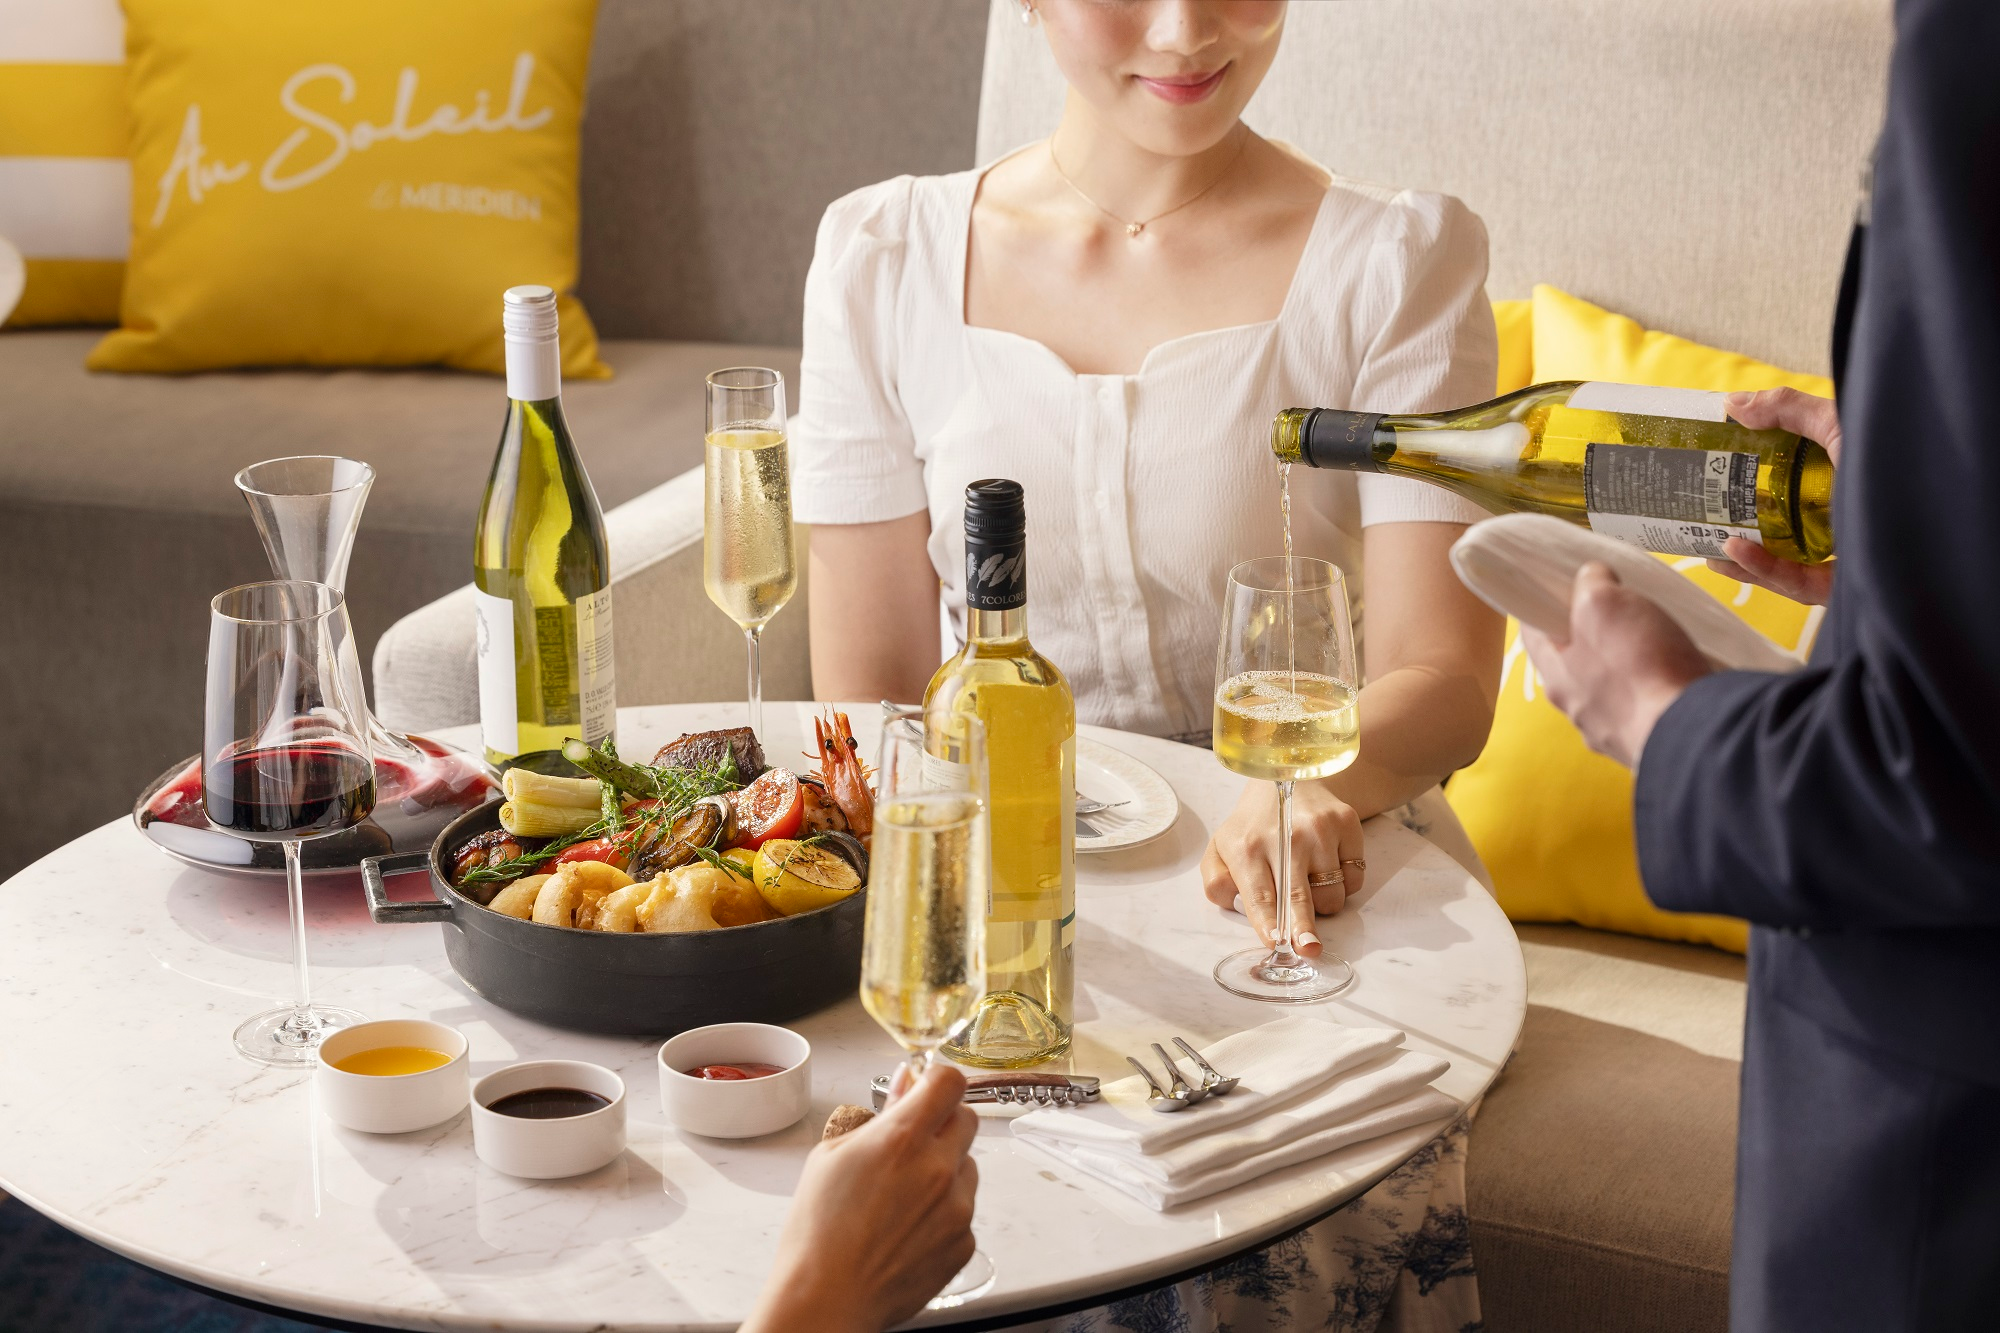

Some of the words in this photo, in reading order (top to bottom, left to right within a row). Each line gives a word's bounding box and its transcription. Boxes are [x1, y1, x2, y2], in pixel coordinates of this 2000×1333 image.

[151, 104, 250, 228] Au
[260, 52, 554, 192] Soleil
[401, 181, 542, 222] MERIDIEN
